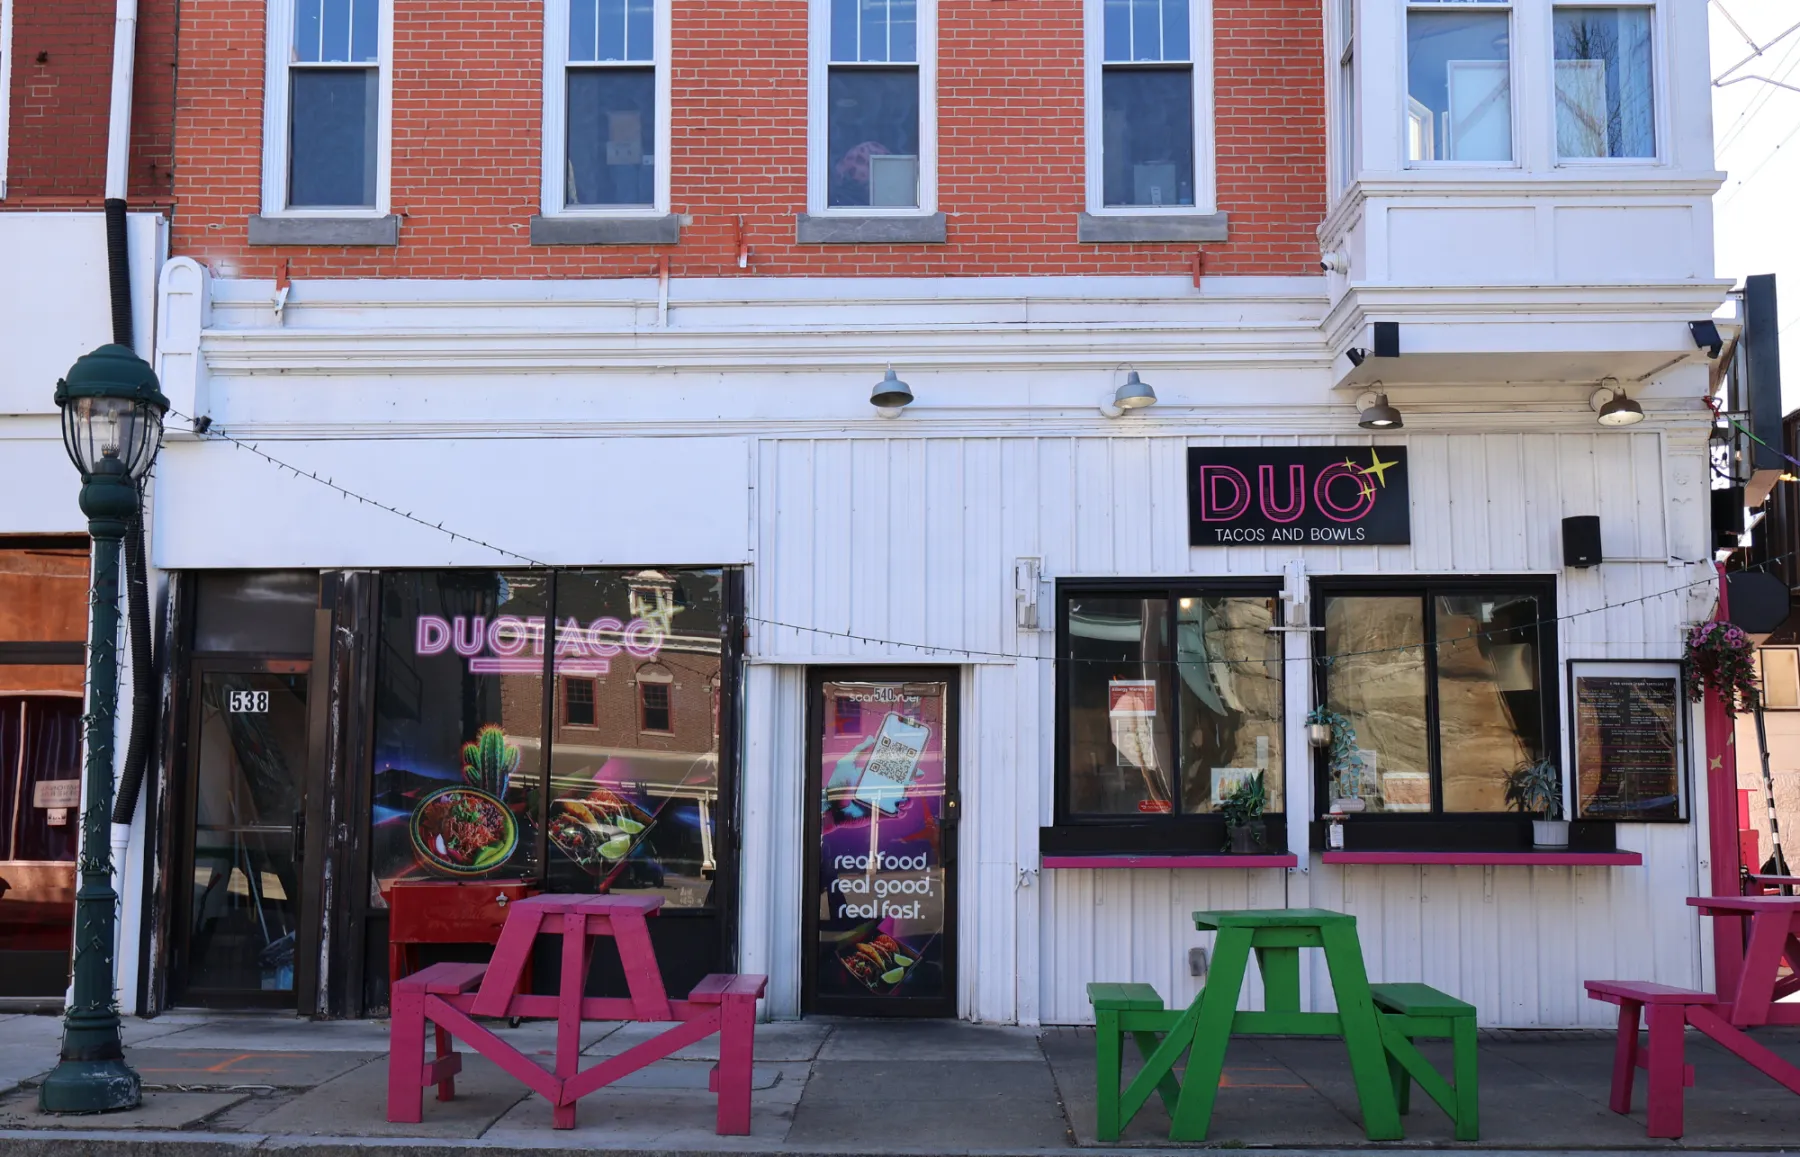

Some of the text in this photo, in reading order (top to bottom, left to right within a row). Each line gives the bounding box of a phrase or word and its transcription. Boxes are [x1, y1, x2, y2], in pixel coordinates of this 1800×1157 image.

[1200, 462, 1376, 523] DUO
[1215, 527, 1366, 542] TACOS AND BOWLS
[232, 691, 267, 712] 538
[874, 687, 894, 701] 540
[834, 850, 874, 870] real
[831, 875, 870, 894] real
[838, 900, 926, 920] real fast.
